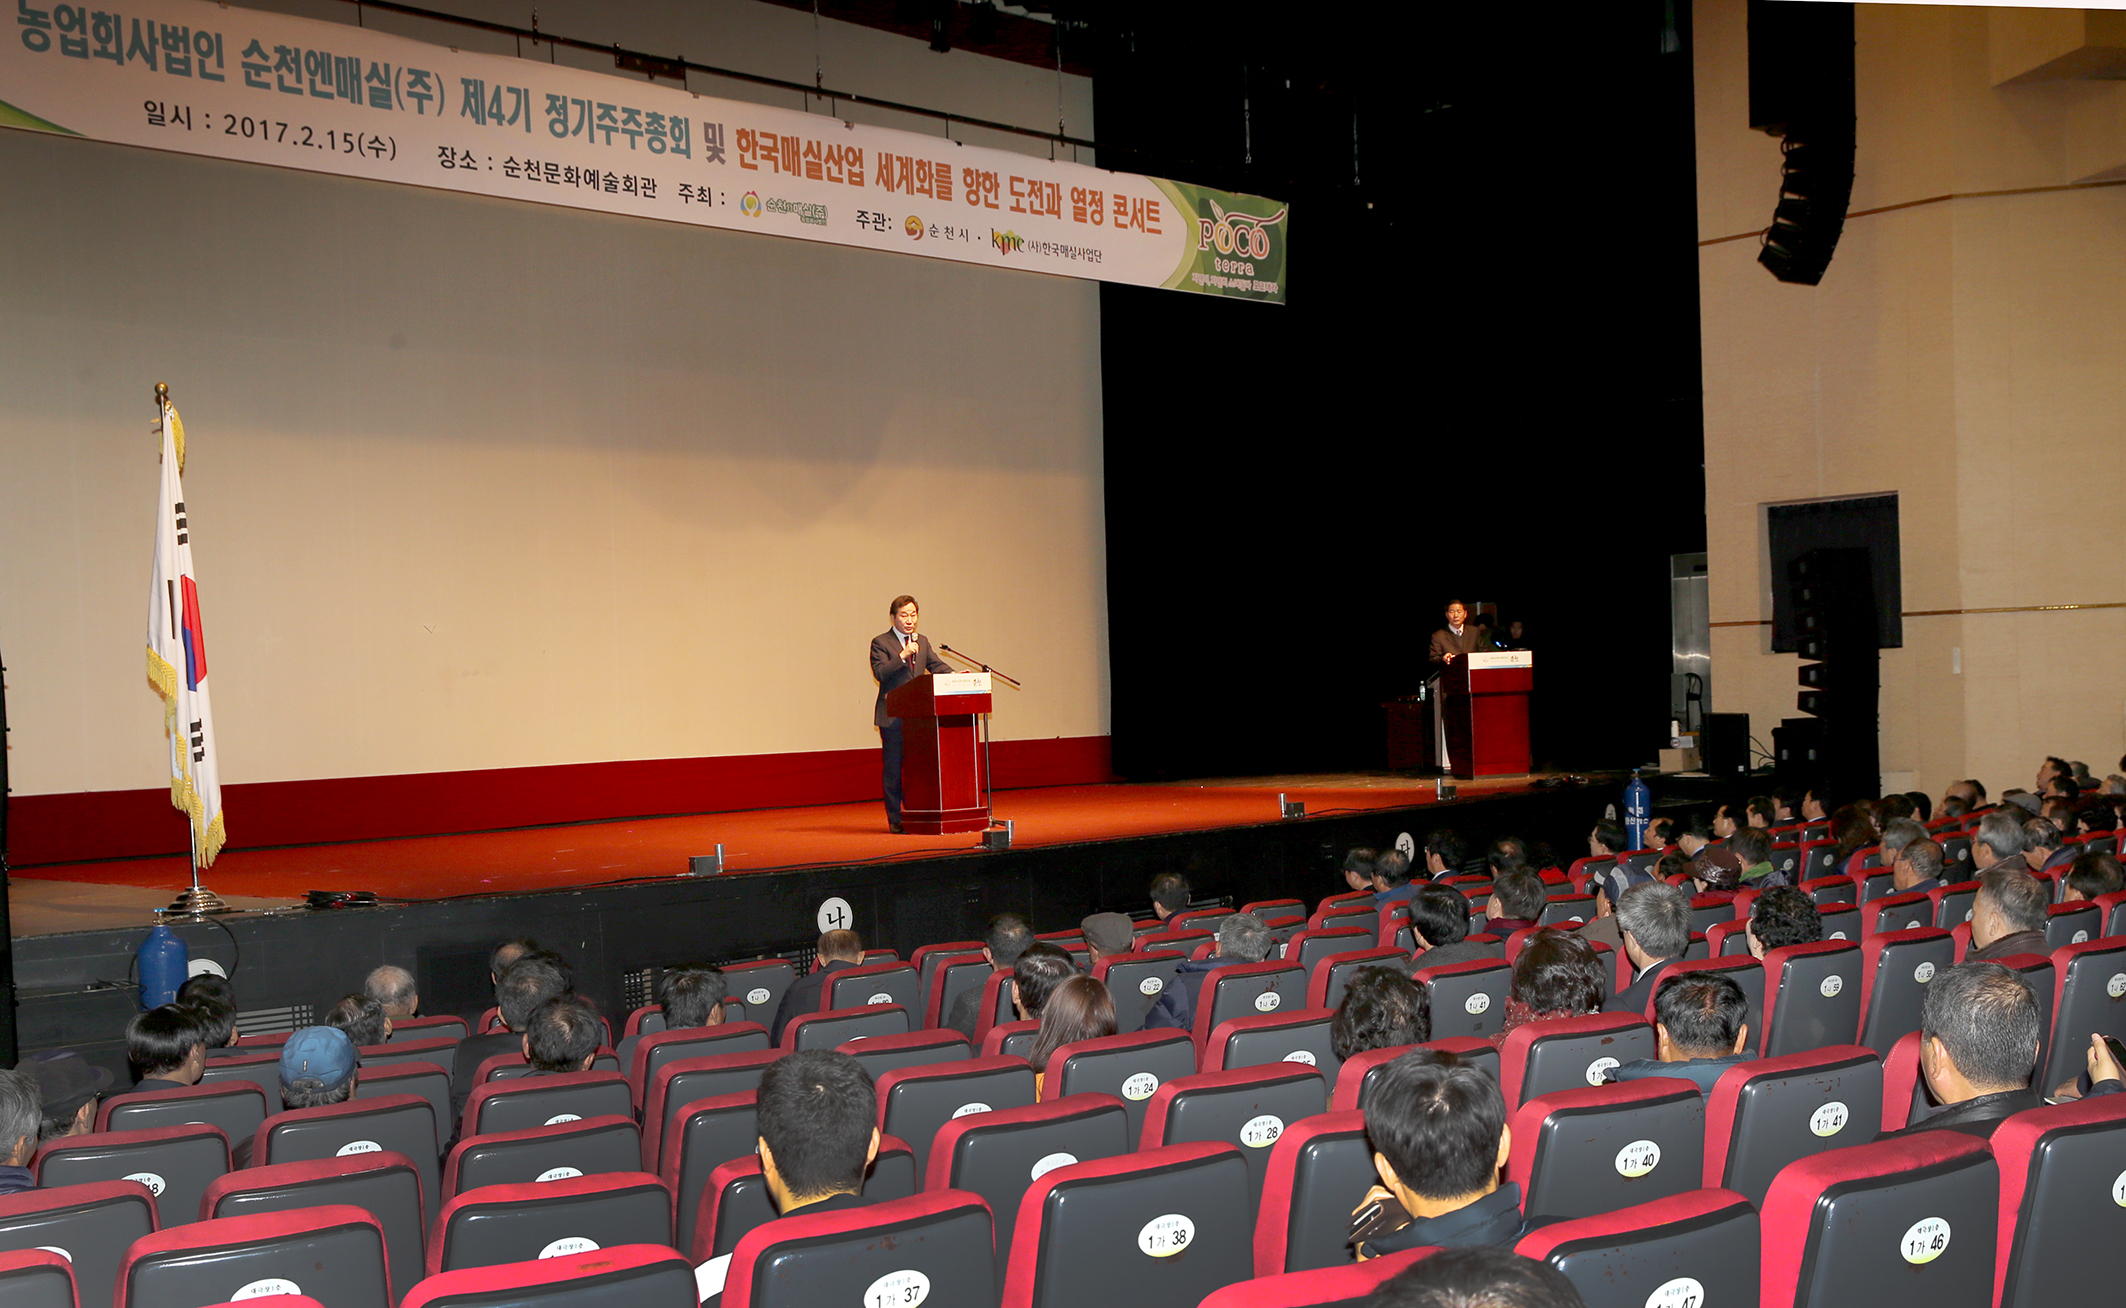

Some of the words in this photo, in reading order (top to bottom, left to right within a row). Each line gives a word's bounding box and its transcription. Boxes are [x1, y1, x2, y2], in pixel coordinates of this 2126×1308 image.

[17, 0, 226, 83] 농업회사법인
[241, 38, 446, 118] 순천엔매실(주)
[460, 77, 533, 133] 제4기
[545, 92, 692, 159] 정기주주총회
[703, 120, 727, 166] 및
[736, 127, 865, 187] 한국매실산업
[875, 151, 954, 202] 세계화를
[962, 166, 1001, 210] 향한
[1009, 175, 1063, 220] 도전과
[1070, 185, 1105, 226] 열정
[1112, 194, 1163, 235] 콘서트
[144, 100, 193, 131] 일시
[223, 114, 398, 162] 2017.2.15(수)
[437, 145, 479, 171] 장소
[502, 156, 658, 199] 순천문화예술회관
[678, 183, 713, 208] 주최
[1027, 241, 1103, 264] (사)한국매실사업단
[1214, 257, 1255, 276] terra
[826, 906, 846, 930] 나
[1142, 1083, 1154, 1093] 24
[1832, 1114, 1843, 1127] 41
[1266, 1127, 1278, 1139] 28
[1643, 1153, 1655, 1166] 40
[1172, 1229, 1187, 1245] 38
[1930, 1234, 1944, 1251] 46
[904, 1285, 921, 1303] 37
